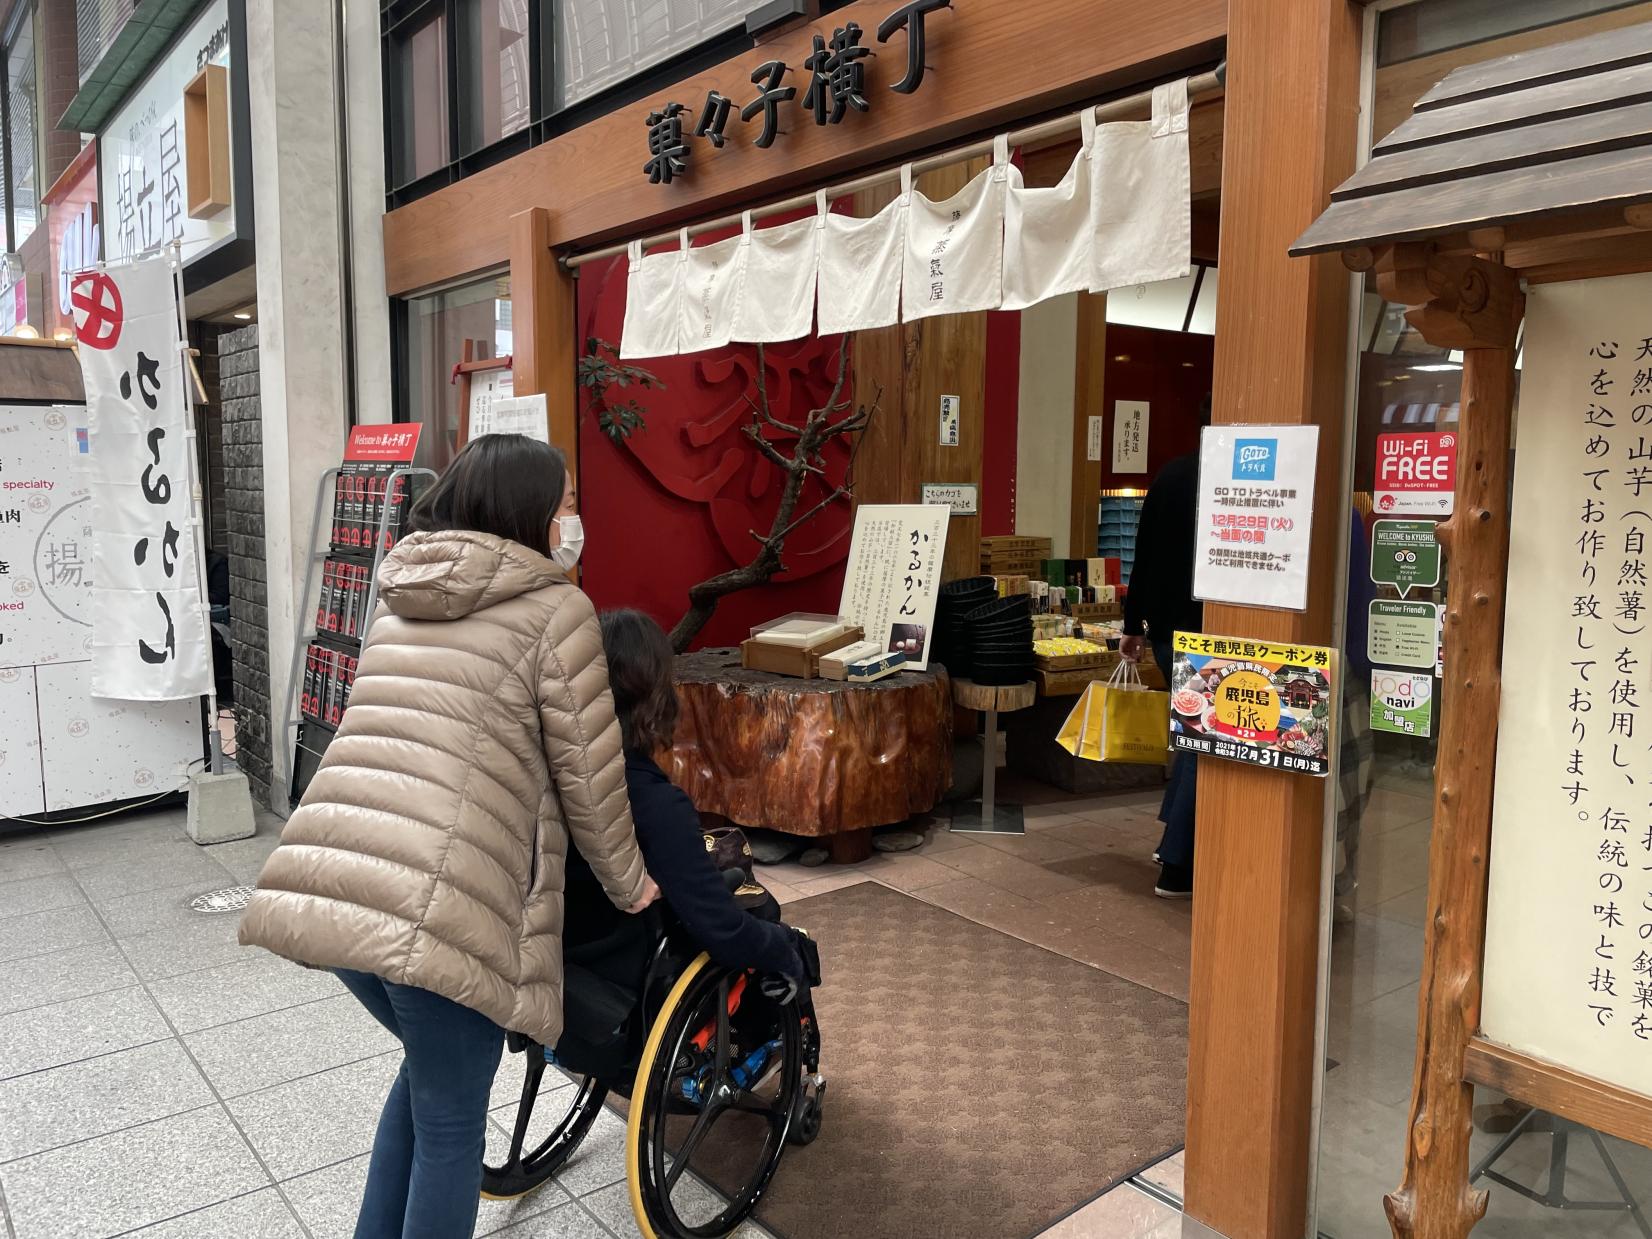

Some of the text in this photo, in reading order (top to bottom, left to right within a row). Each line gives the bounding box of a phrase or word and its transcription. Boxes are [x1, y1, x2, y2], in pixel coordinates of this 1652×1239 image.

[643, 0, 953, 184] 菓々子横丁
[1383, 440, 1429, 456] Wi-Fi
[1381, 455, 1449, 480] FREE
[3, 480, 55, 501] specialty
[1214, 487, 1229, 496] GO
[1233, 488, 1246, 496] TO
[899, 529, 930, 615] かるかん
[1379, 604, 1427, 615] Traveler Friendly
[1178, 635, 1329, 666] 今こそ鹿児島クーポン券
[1225, 687, 1270, 707] 鹿児島
[1386, 696, 1415, 708] navi
